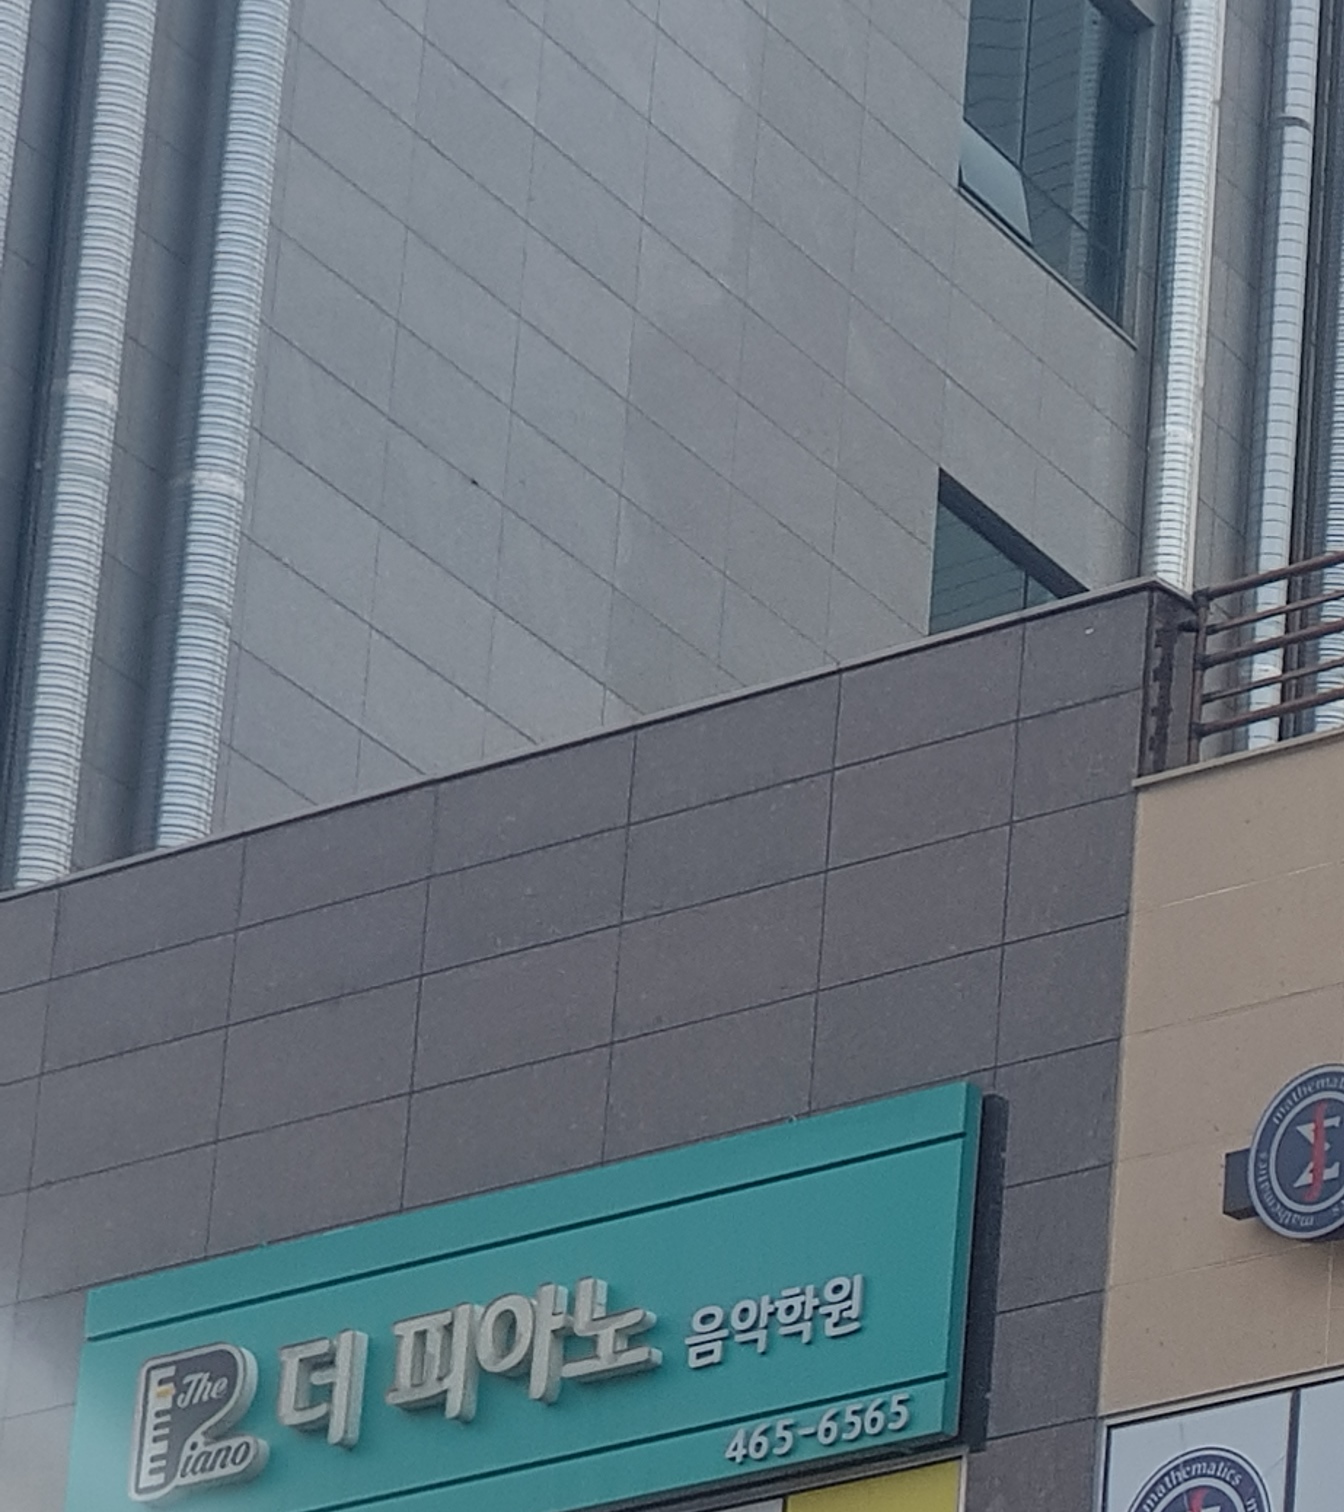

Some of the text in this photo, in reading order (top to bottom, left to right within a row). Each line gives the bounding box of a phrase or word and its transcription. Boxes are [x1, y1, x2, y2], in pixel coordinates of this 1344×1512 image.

[176, 1370, 228, 1407] The
[278, 1274, 864, 1449] 더 피아노 음악학원
[725, 1394, 910, 1464] 465-6565
[1143, 1461, 1242, 1512] mathematics
